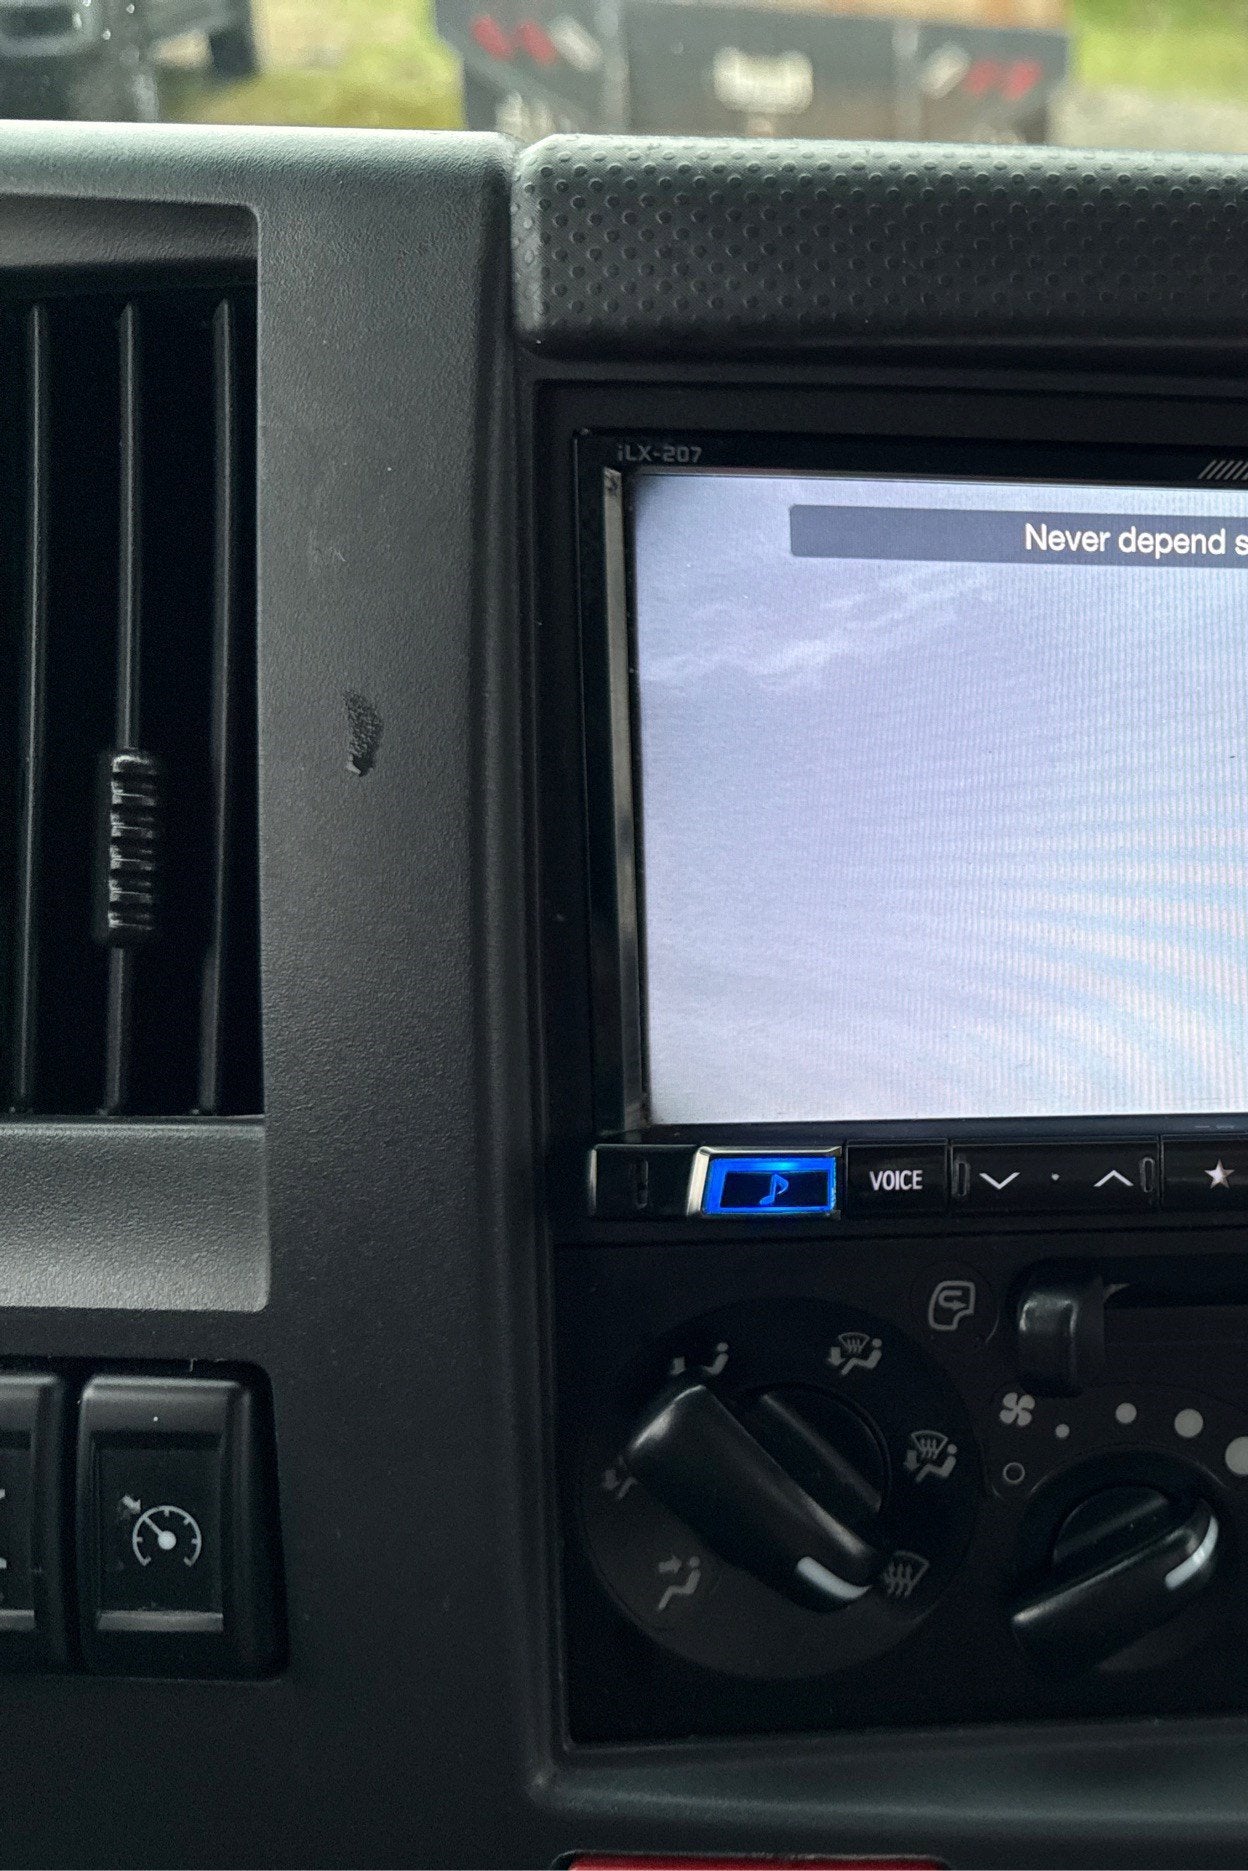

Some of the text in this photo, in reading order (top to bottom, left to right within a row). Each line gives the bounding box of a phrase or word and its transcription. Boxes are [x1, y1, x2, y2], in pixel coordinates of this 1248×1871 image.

[617, 443, 703, 463] iLX-207
[1024, 522, 1111, 551] Never
[1118, 525, 1226, 560] depend
[868, 1169, 924, 1191] VOICE
